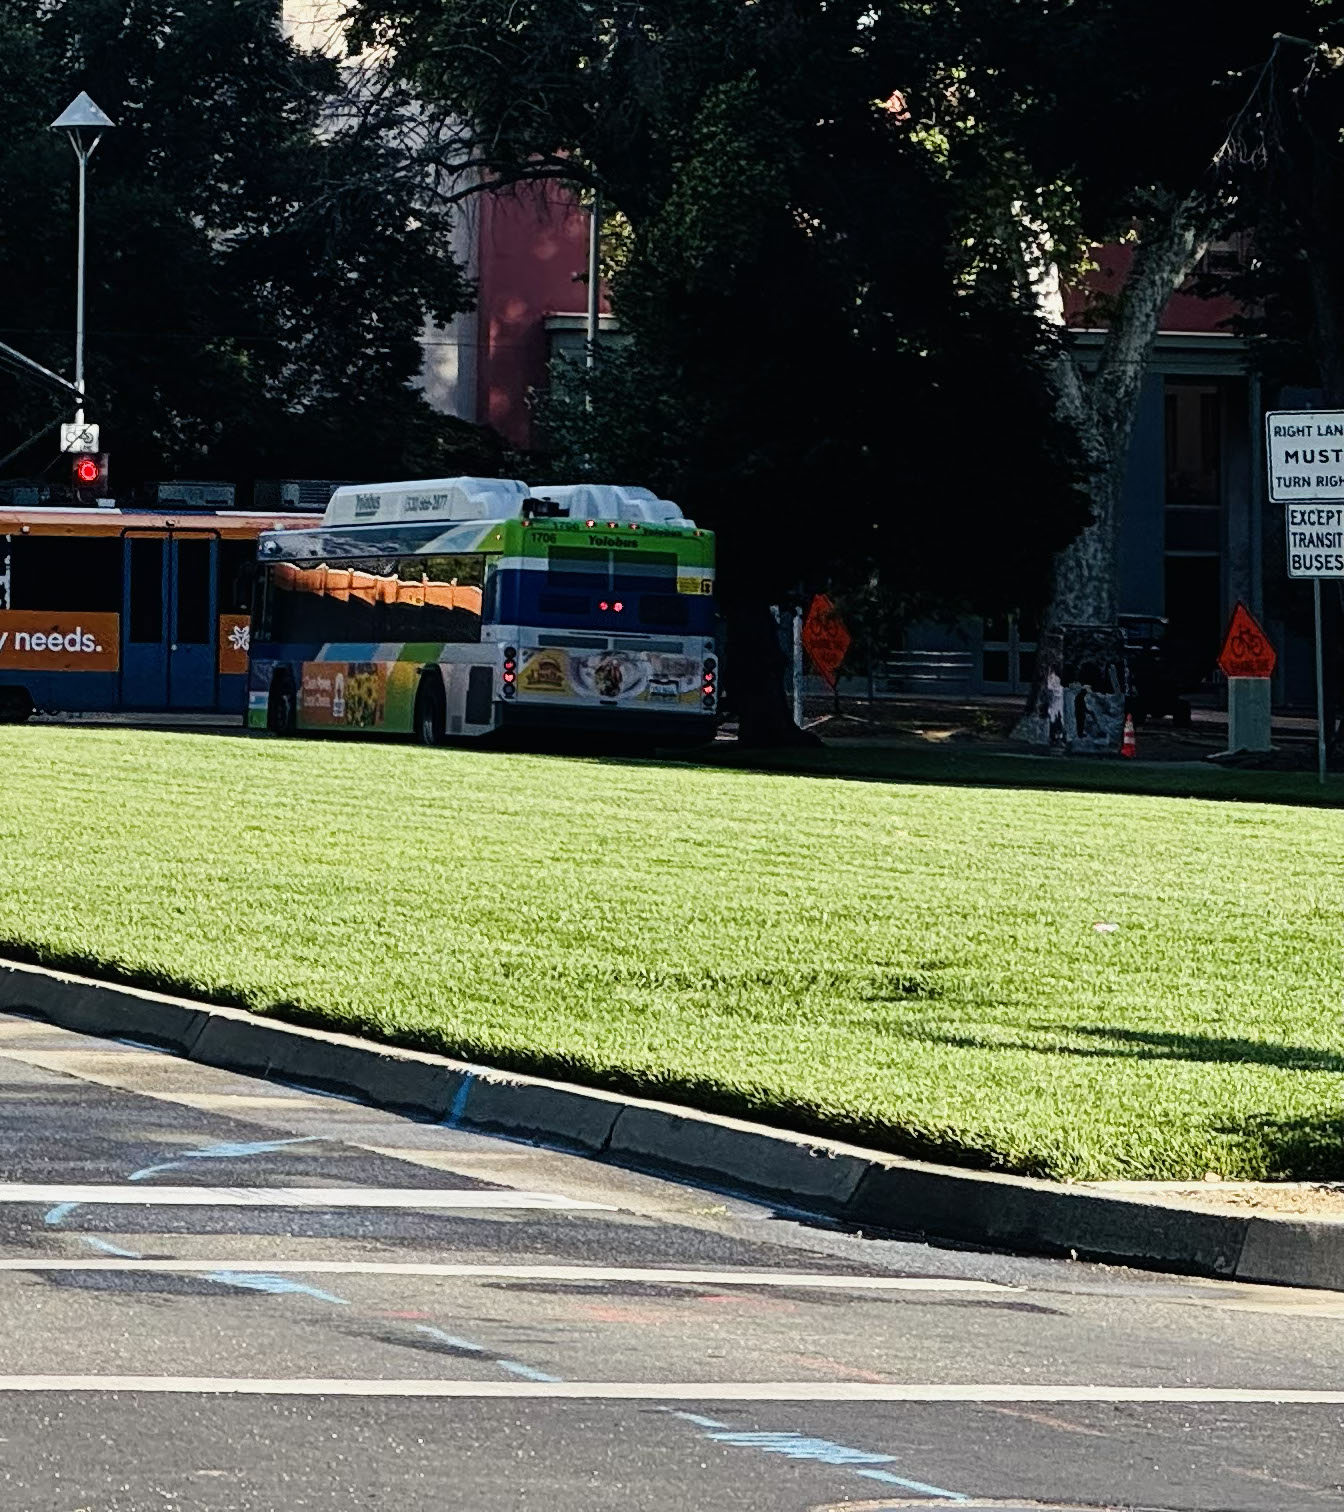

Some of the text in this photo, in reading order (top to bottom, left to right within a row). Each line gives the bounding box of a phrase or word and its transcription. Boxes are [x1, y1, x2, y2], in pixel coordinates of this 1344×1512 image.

[1273, 424, 1344, 438] RIGHT LAN
[1285, 449, 1343, 464] MUST
[1275, 475, 1344, 489] TURN RIGH
[1290, 509, 1343, 526] EXCEPT
[588, 535, 639, 548] Yolobus
[1291, 532, 1343, 548] TRANSIT
[1292, 554, 1344, 571] BUSES
[14, 626, 103, 653] needs.
